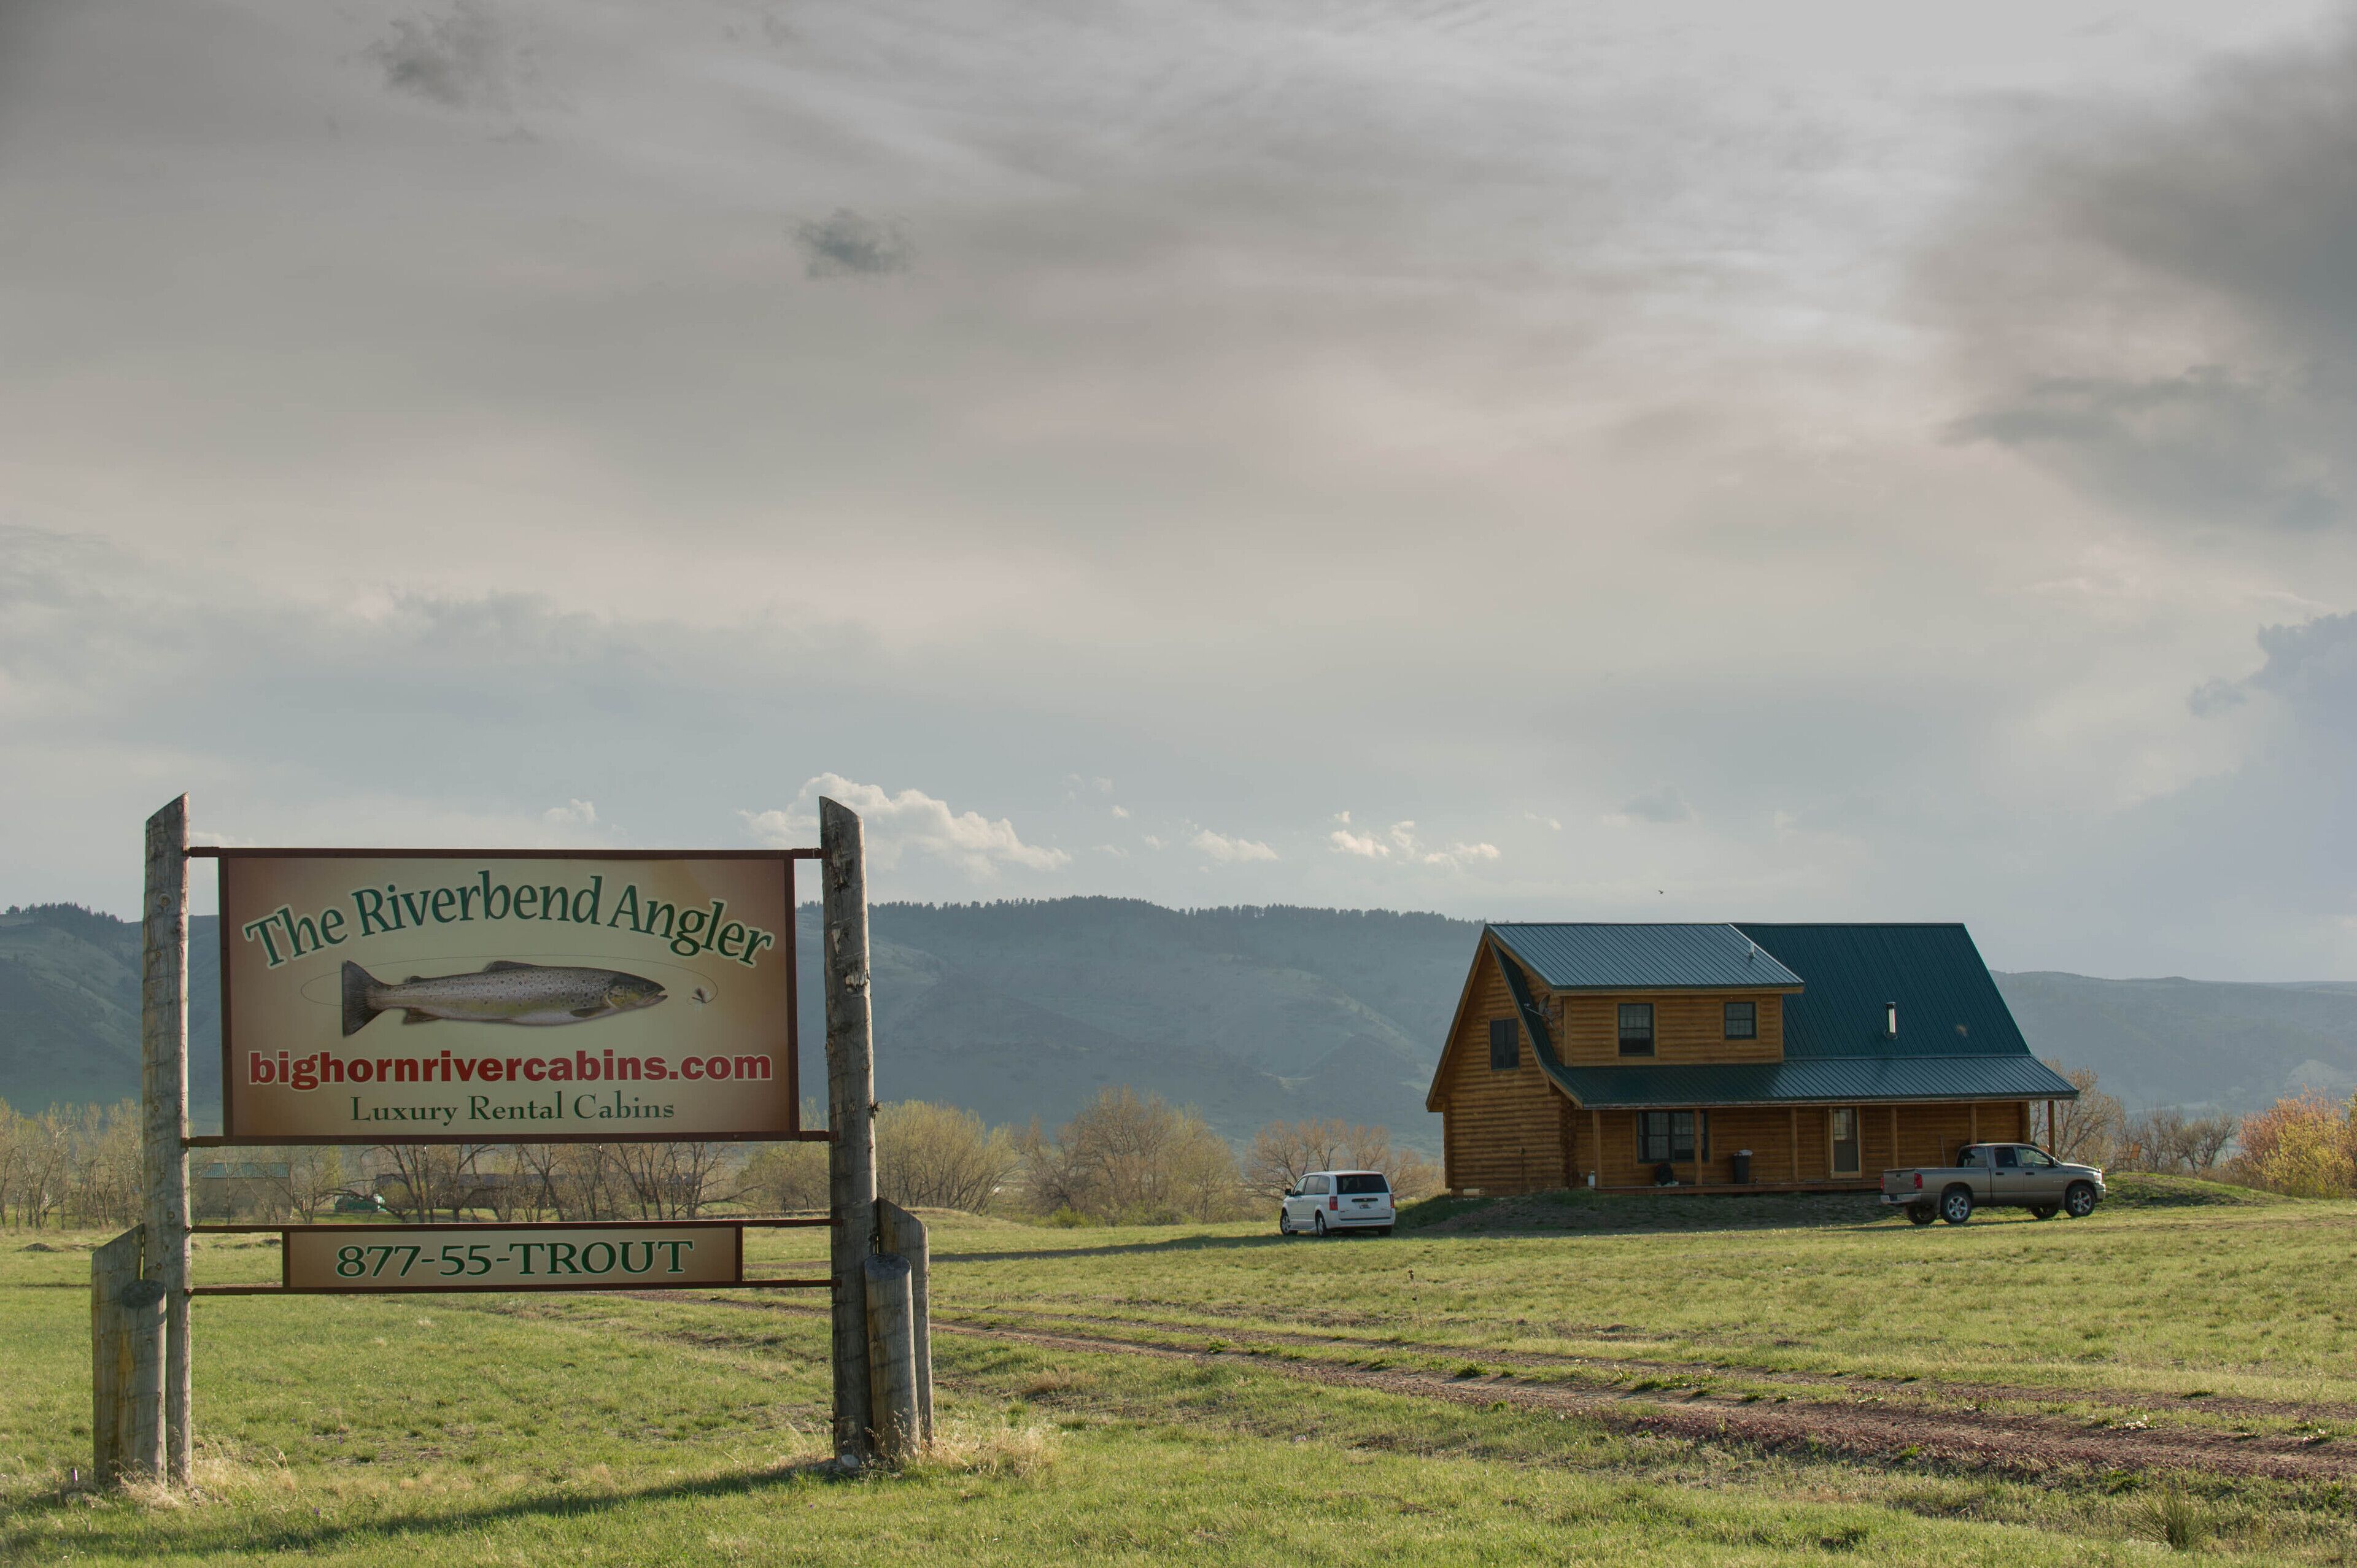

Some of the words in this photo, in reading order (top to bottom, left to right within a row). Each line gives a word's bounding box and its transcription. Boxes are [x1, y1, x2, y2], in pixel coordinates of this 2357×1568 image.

[246, 908, 348, 967] The
[351, 870, 602, 936] Riverbend
[607, 884, 772, 965] Angler
[250, 1049, 772, 1089] bighornrivercabins.com
[350, 1096, 458, 1126] Luxury
[468, 1091, 563, 1120] Rental
[574, 1090, 675, 1119] Cabins
[336, 1240, 694, 1277] 877-55-TROUT
